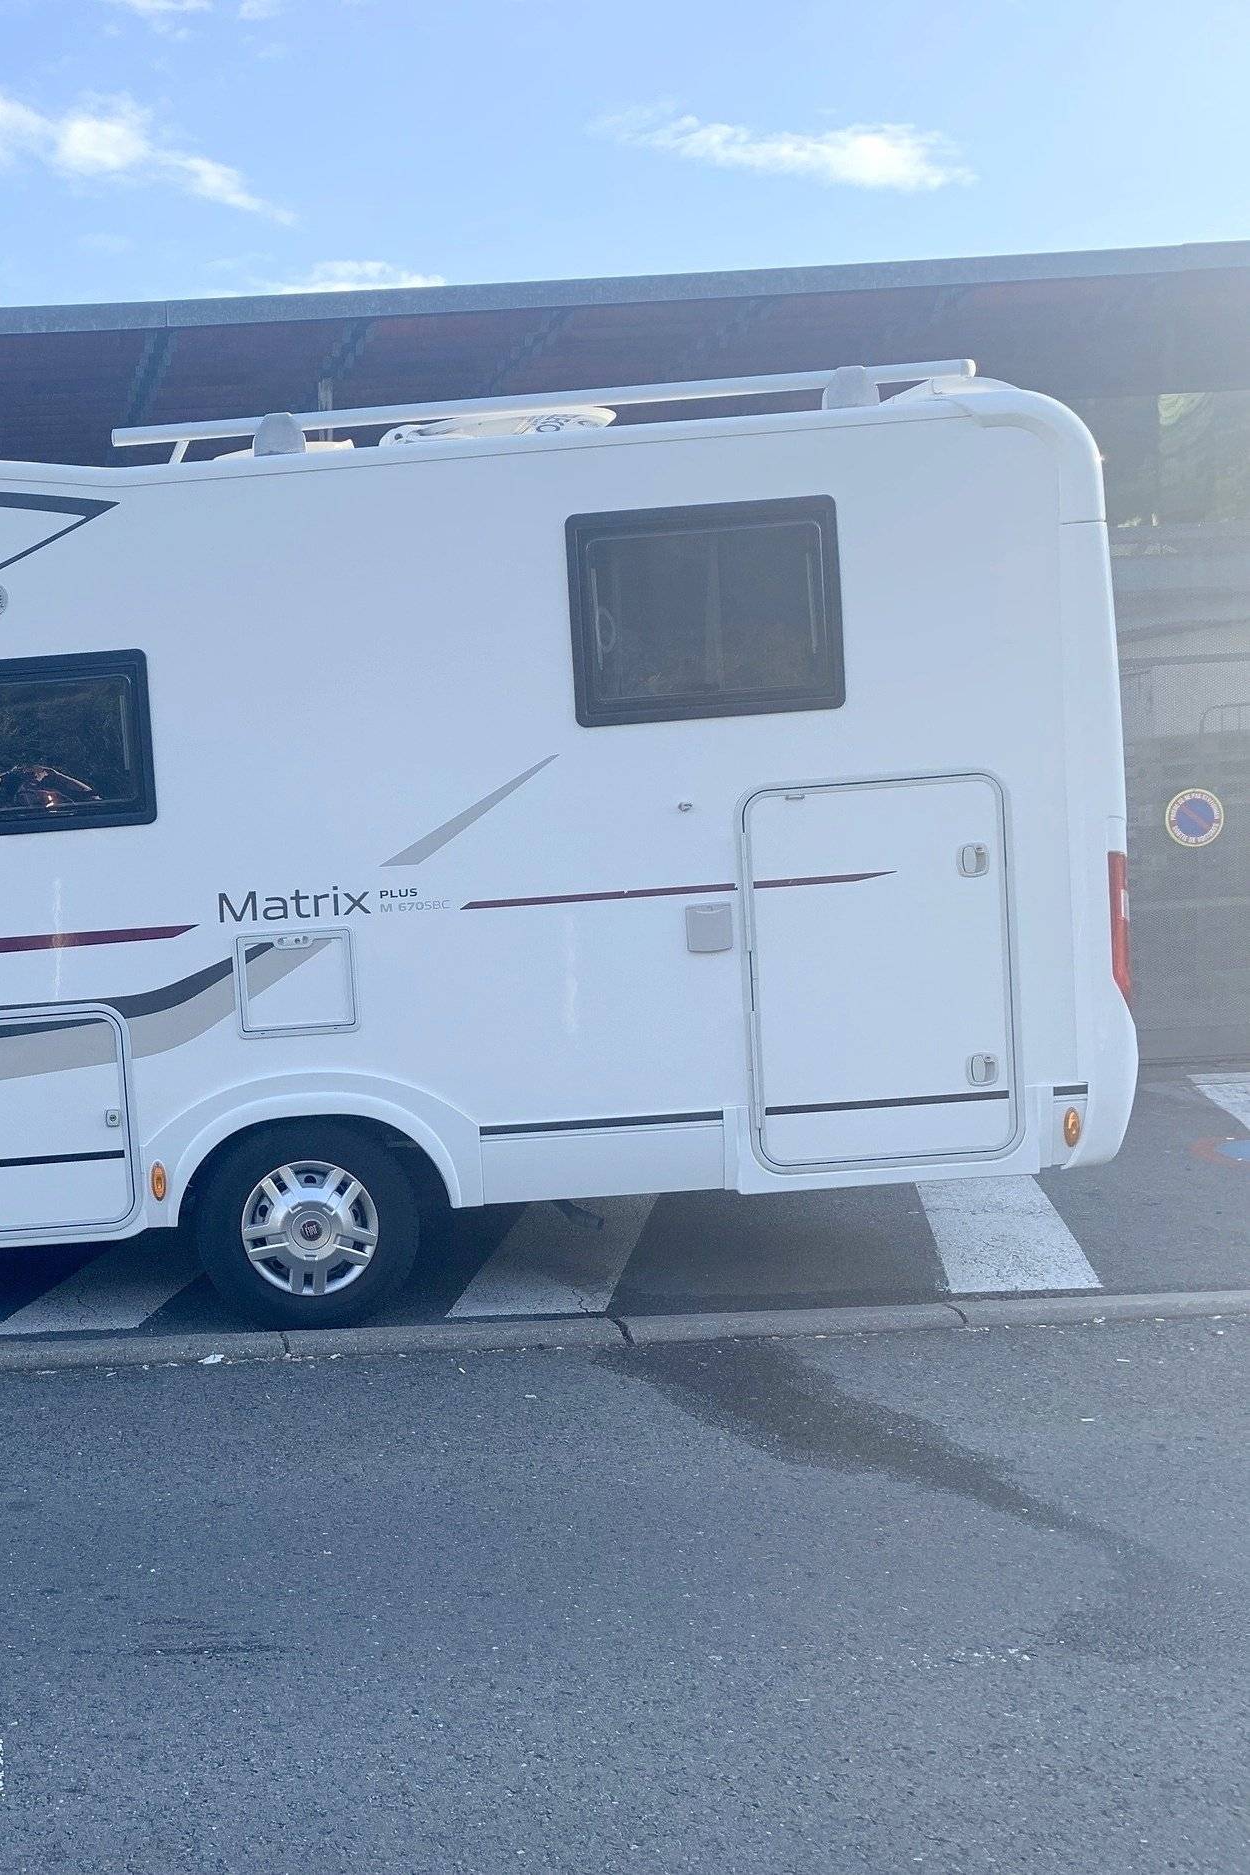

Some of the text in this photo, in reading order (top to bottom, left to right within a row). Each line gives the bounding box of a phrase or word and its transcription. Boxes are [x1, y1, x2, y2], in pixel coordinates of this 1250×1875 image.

[218, 886, 418, 923] Matrix PLUS
[380, 903, 393, 913] M
